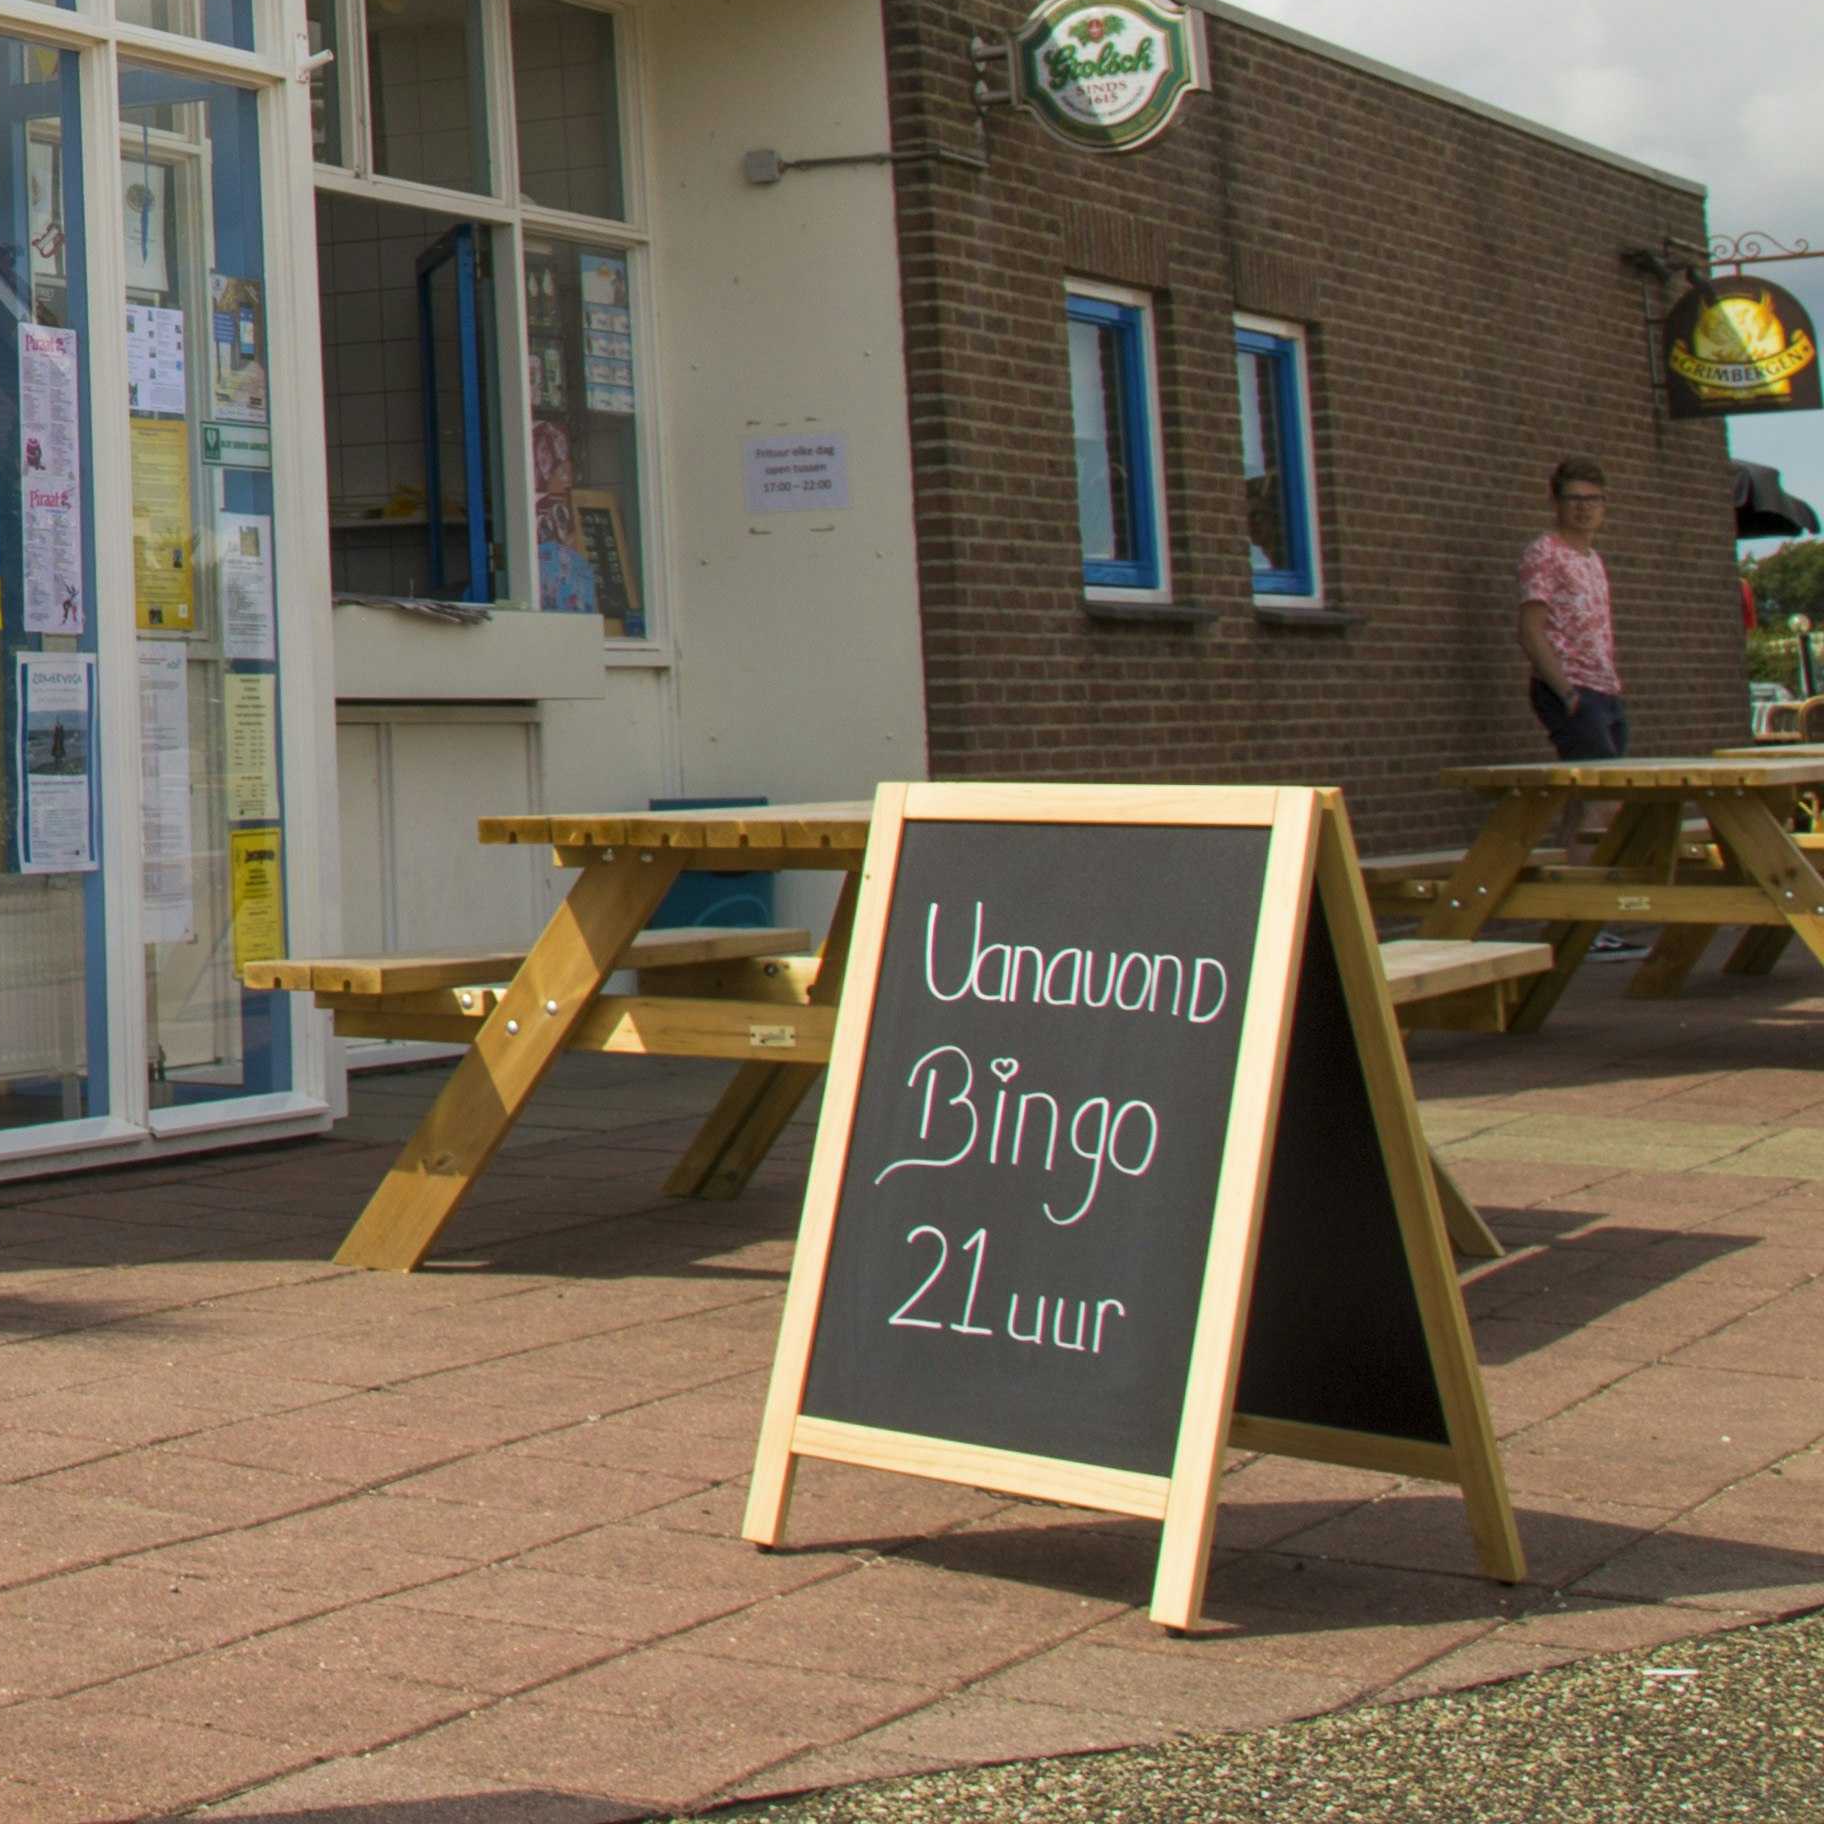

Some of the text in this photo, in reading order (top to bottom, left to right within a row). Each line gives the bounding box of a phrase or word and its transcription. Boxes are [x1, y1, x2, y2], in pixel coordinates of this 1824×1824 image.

[1044, 36, 1154, 90] Grolsch
[1076, 79, 1128, 97] SINDS
[1680, 350, 1804, 383] GRIMBERGEN
[874, 1044, 1158, 1226] Bingo
[887, 1224, 1127, 1354] 21 uur
